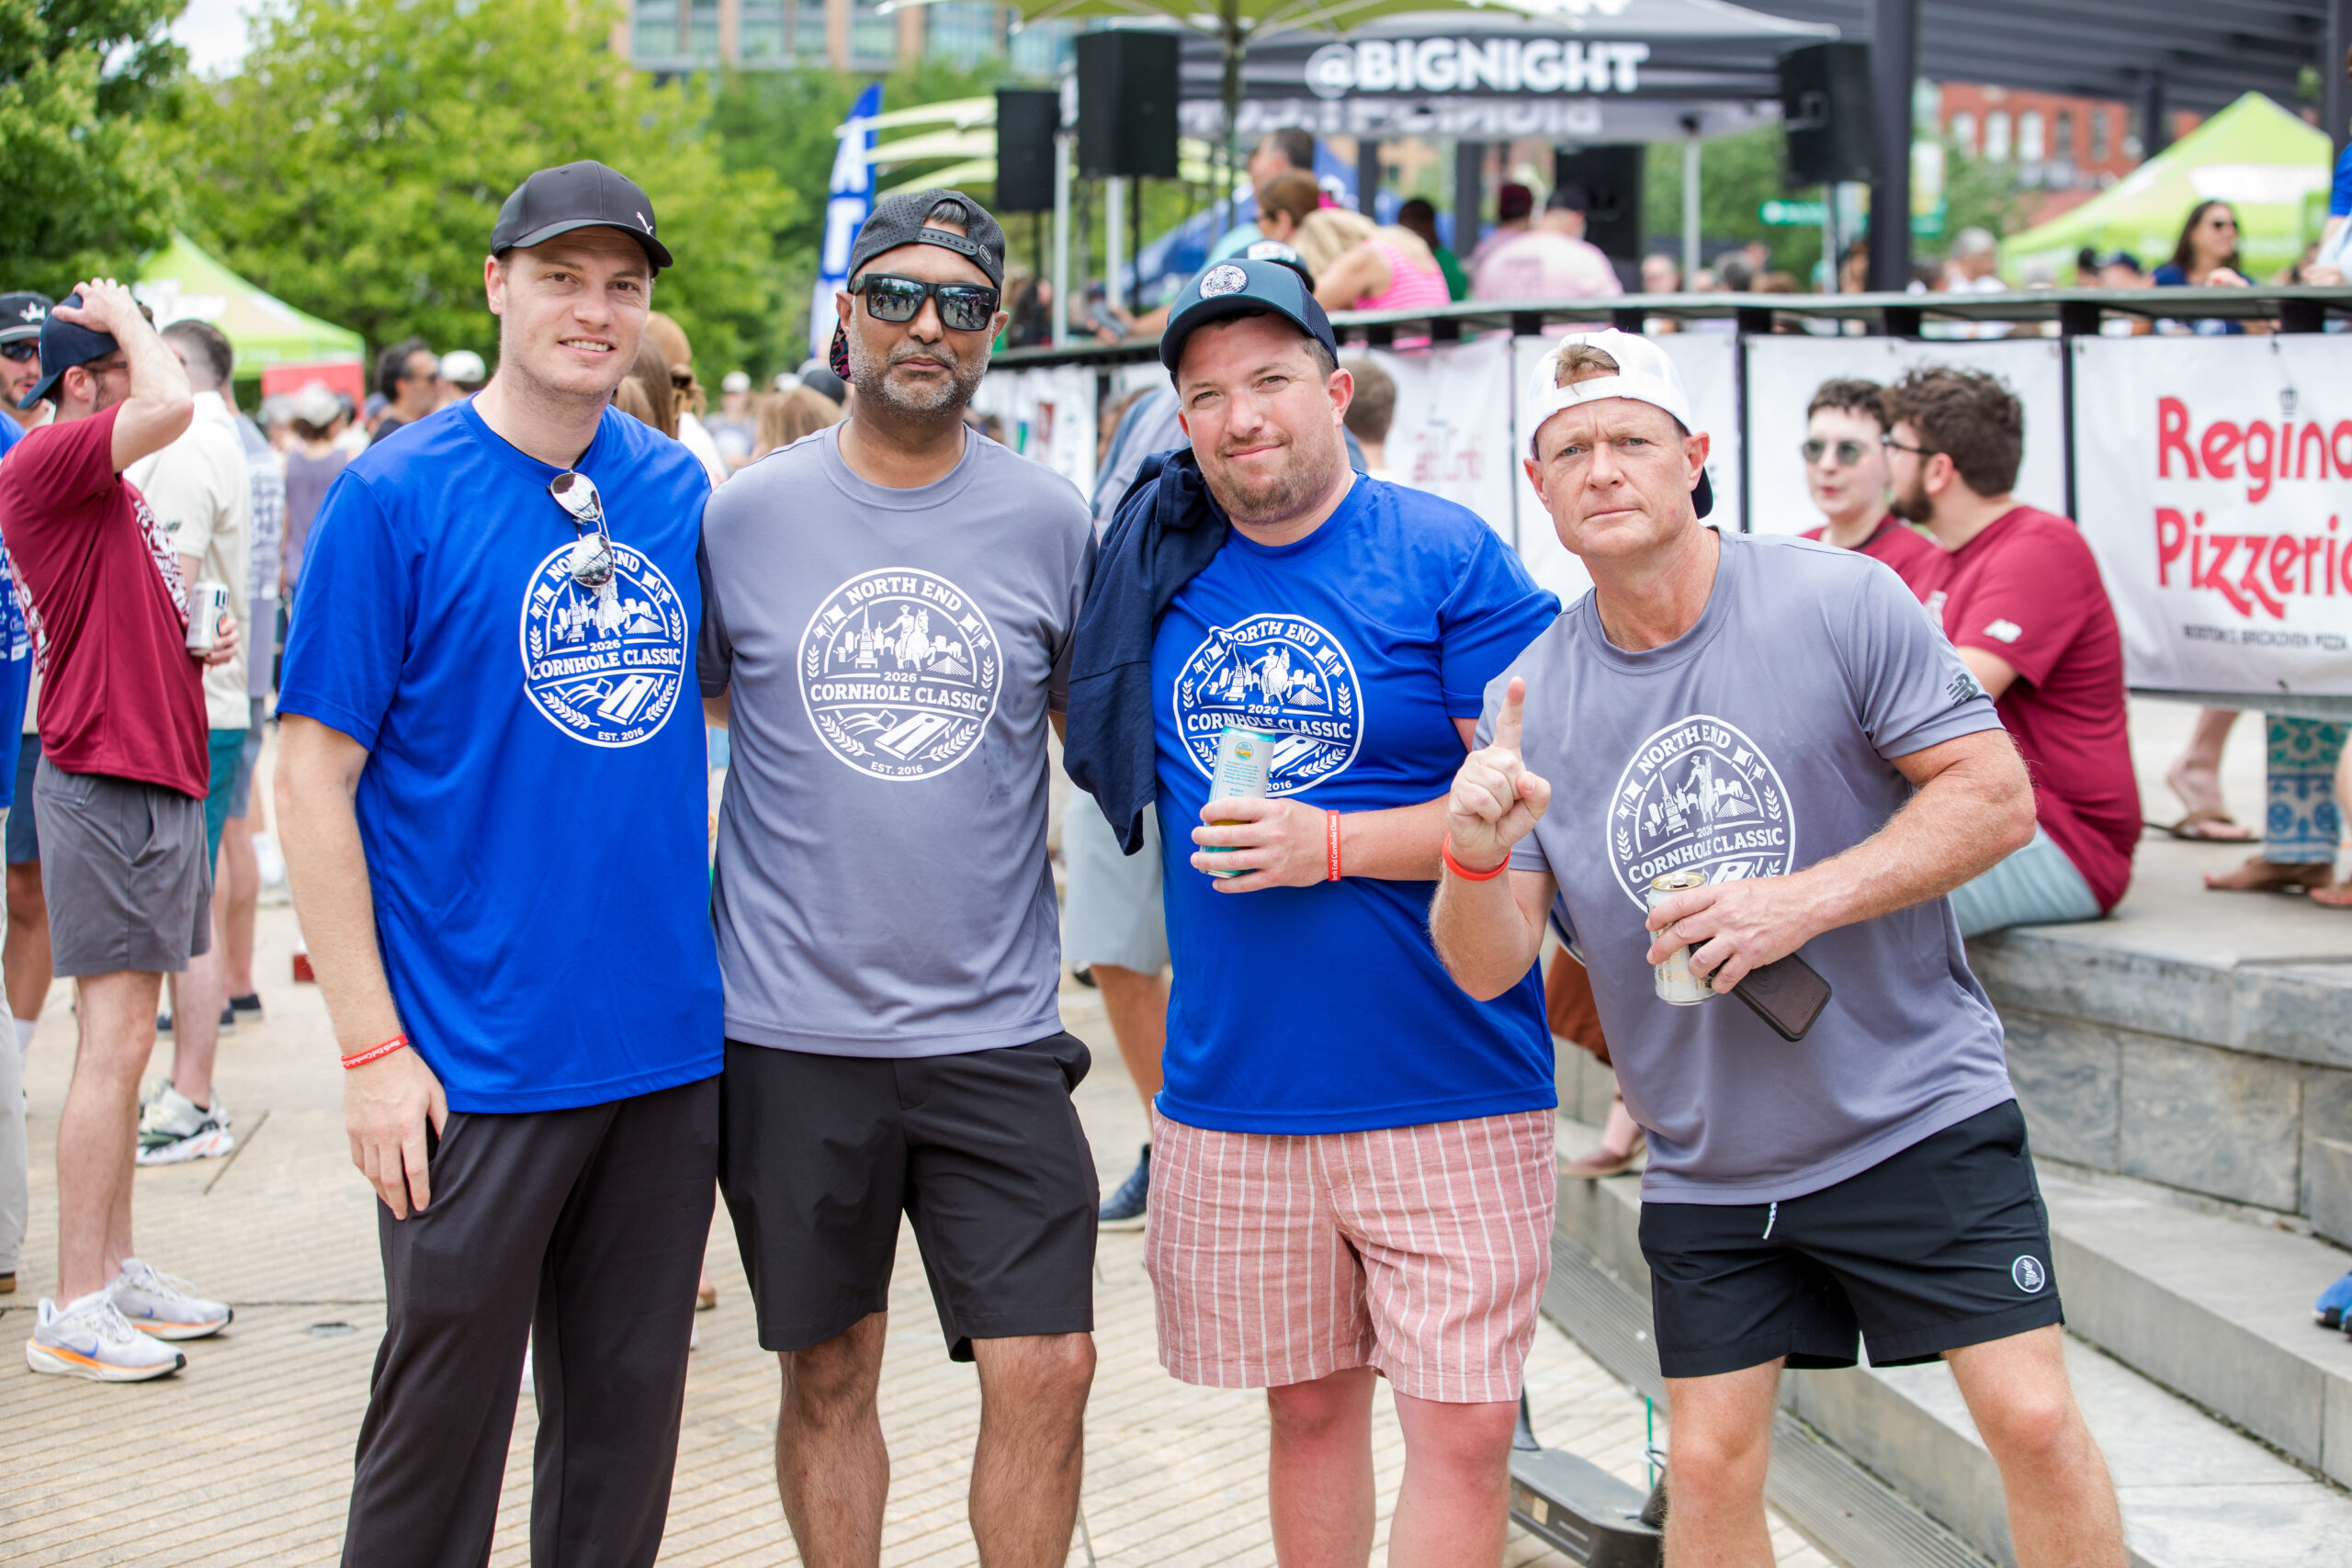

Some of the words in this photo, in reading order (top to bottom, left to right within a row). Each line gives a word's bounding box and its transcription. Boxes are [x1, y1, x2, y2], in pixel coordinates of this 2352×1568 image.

[1304, 37, 1651, 99] @BIGNIGHT
[845, 576, 918, 606] NORTH
[921, 580, 962, 612] END
[589, 638, 622, 652] 2026
[1218, 620, 1284, 644] NORTH
[1284, 624, 1320, 647] END
[530, 651, 621, 681] CORNHOLE
[623, 648, 682, 666] CLASSIC
[883, 671, 918, 683] 2026
[810, 683, 911, 702] CORNHOLE
[915, 686, 989, 713] CLASSIC
[1248, 704, 1280, 715] 2026
[597, 731, 620, 742] EST.
[621, 727, 645, 740] 2016
[1187, 712, 1278, 732] CORNHOLE
[1278, 718, 1352, 739] CLASSIC
[1636, 724, 1702, 776] NORTH
[1701, 724, 1732, 750] END
[870, 761, 895, 774] EST.
[897, 764, 924, 775] 2016
[1266, 780, 1293, 791] 2016
[1696, 824, 1713, 839] 2026
[1628, 839, 1713, 884] CORNHOLE
[1713, 827, 1786, 854] CLASSIC
